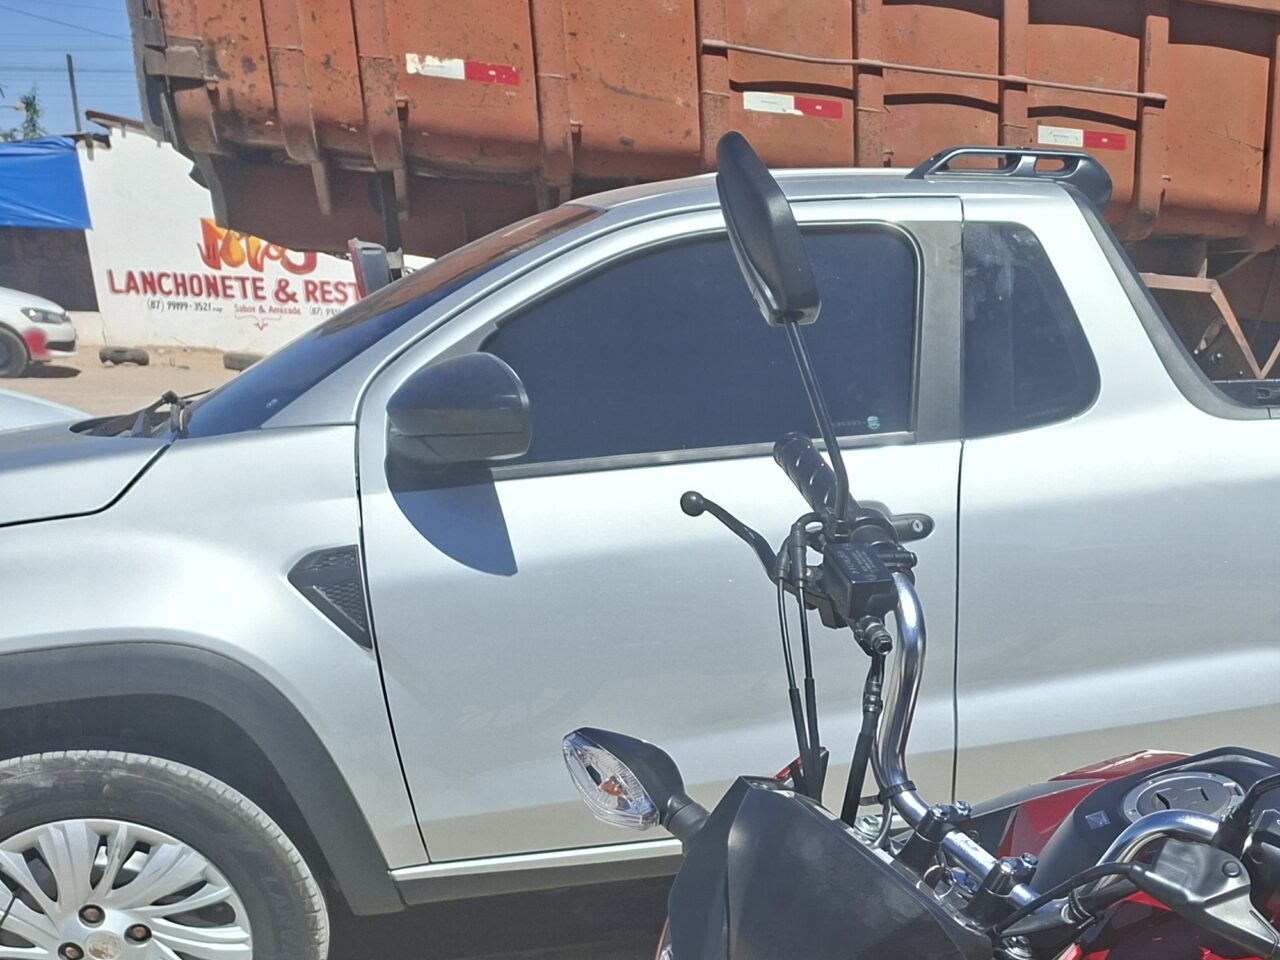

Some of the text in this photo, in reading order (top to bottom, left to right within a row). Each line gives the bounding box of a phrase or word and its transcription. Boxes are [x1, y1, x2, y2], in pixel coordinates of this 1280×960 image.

[107, 269, 266, 300] LANCHONETE
[274, 279, 298, 303] &
[147, 297, 164, 312] (87)
